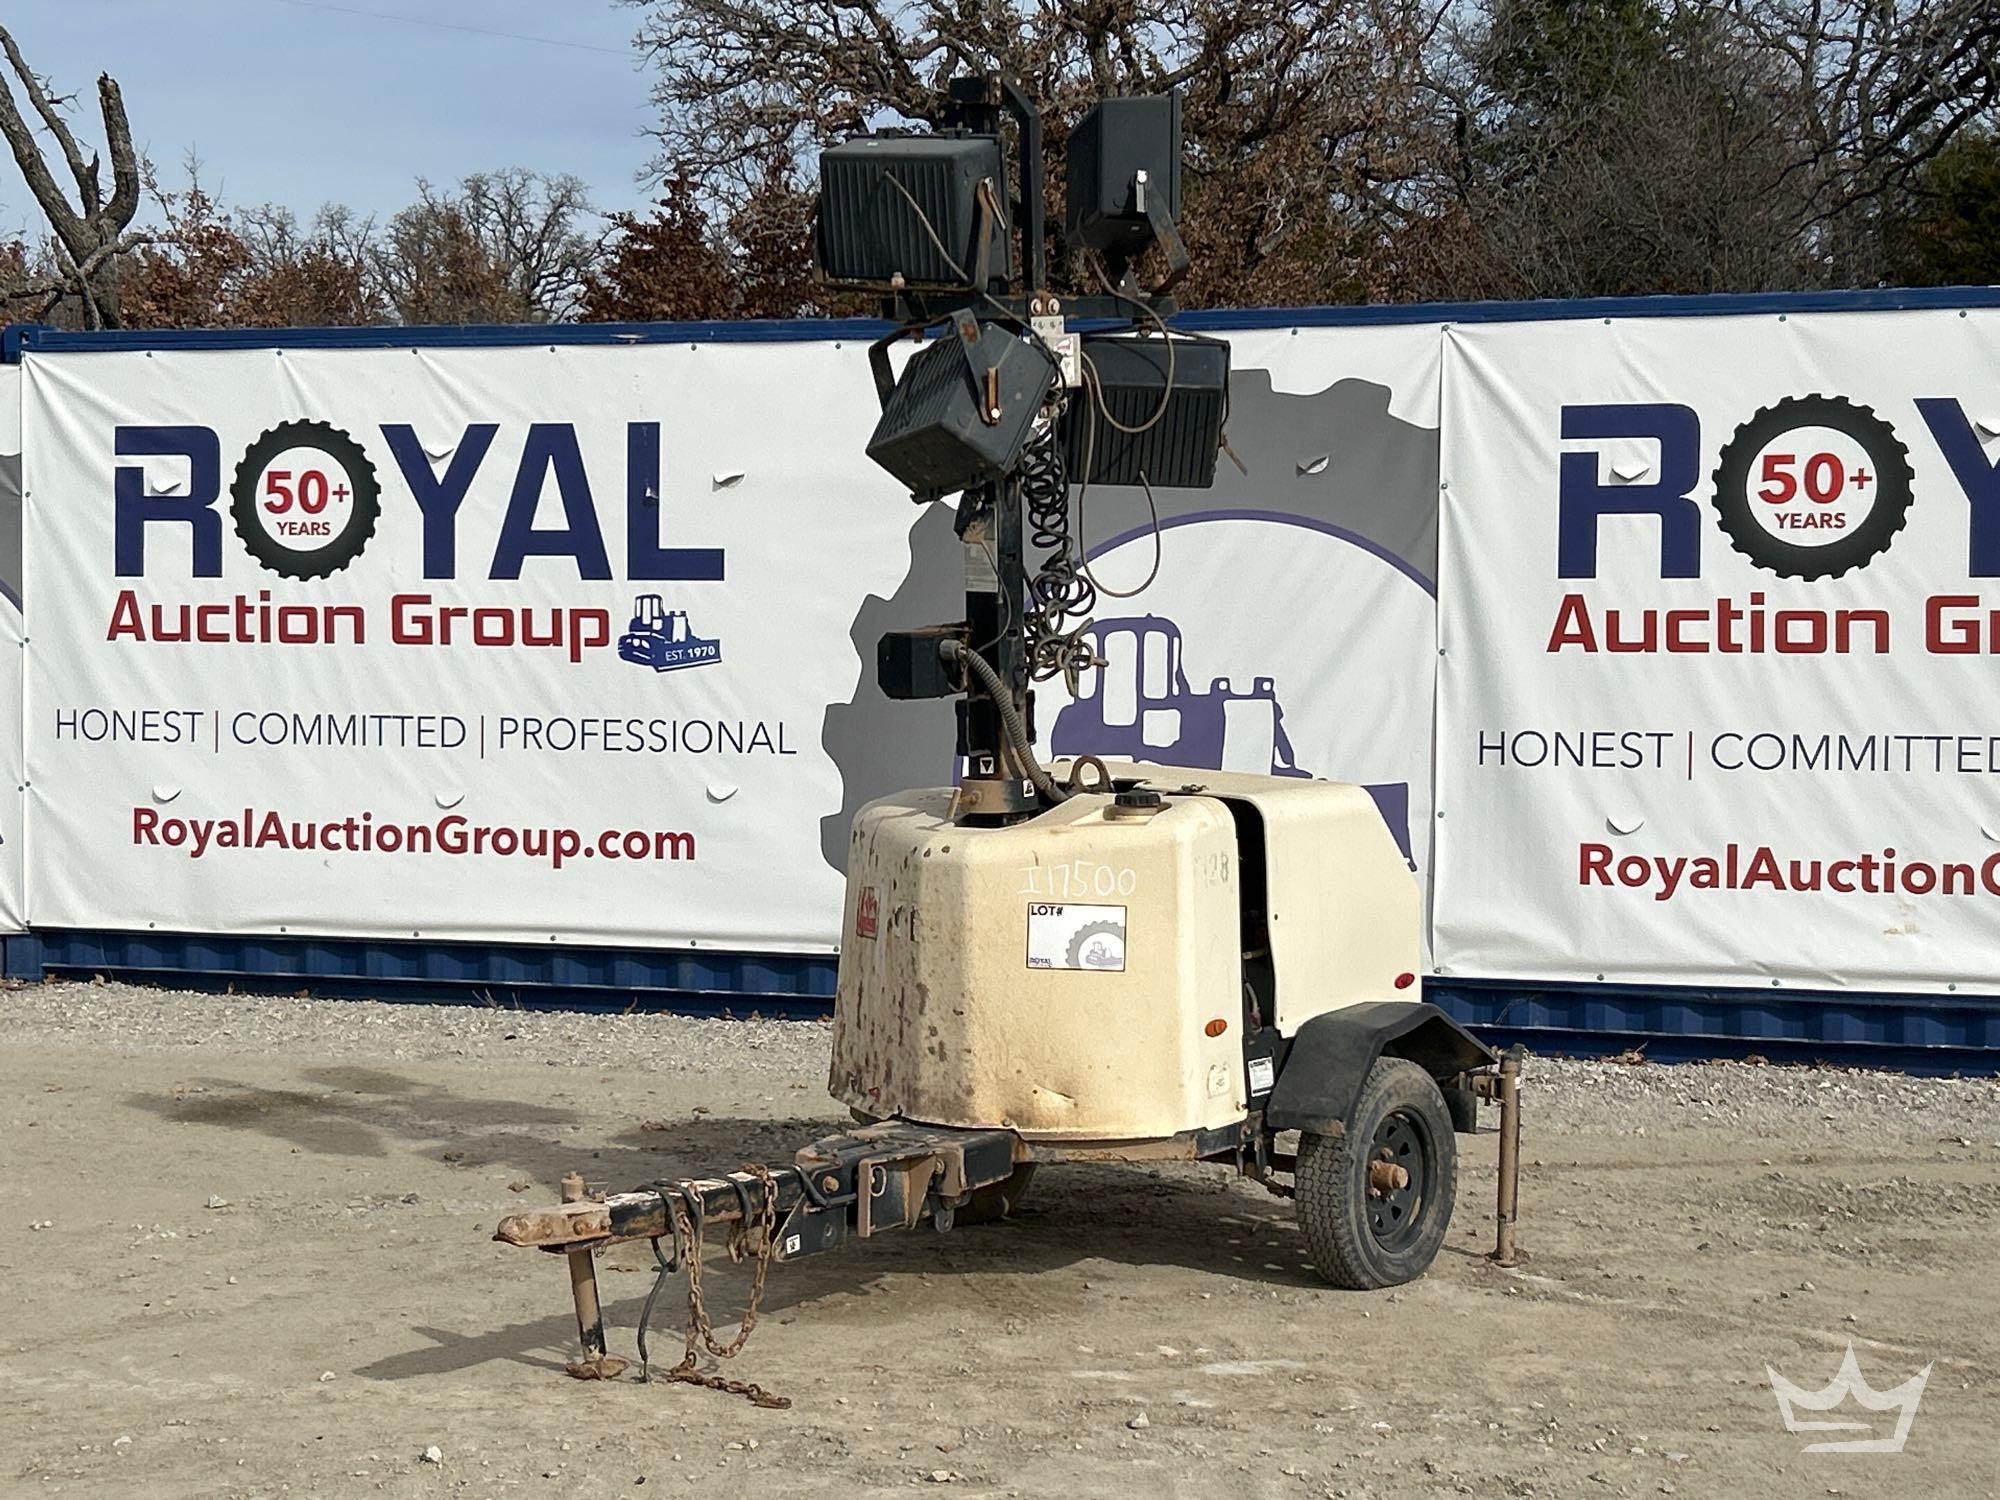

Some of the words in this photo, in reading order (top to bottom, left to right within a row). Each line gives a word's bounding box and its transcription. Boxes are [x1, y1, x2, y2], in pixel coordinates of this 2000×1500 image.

[115, 419, 726, 582] ROYAL
[263, 470, 351, 513] 50+
[1758, 453, 1873, 505] 50+
[276, 520, 332, 537] YEARS
[1774, 512, 1847, 530] YEARS
[107, 590, 365, 645] Auction
[390, 593, 610, 663] Group
[1546, 592, 1890, 655] Auction
[665, 649, 687, 661] EST.
[687, 645, 716, 658] 1970
[55, 708, 205, 744] HONEST
[231, 711, 467, 749] COMMITTED
[499, 717, 798, 756] PROFESSIONAL
[1478, 730, 1674, 769] HONEST
[132, 807, 696, 869] RoyalAuctionGroup.com
[1030, 905, 1064, 916] LOT#
